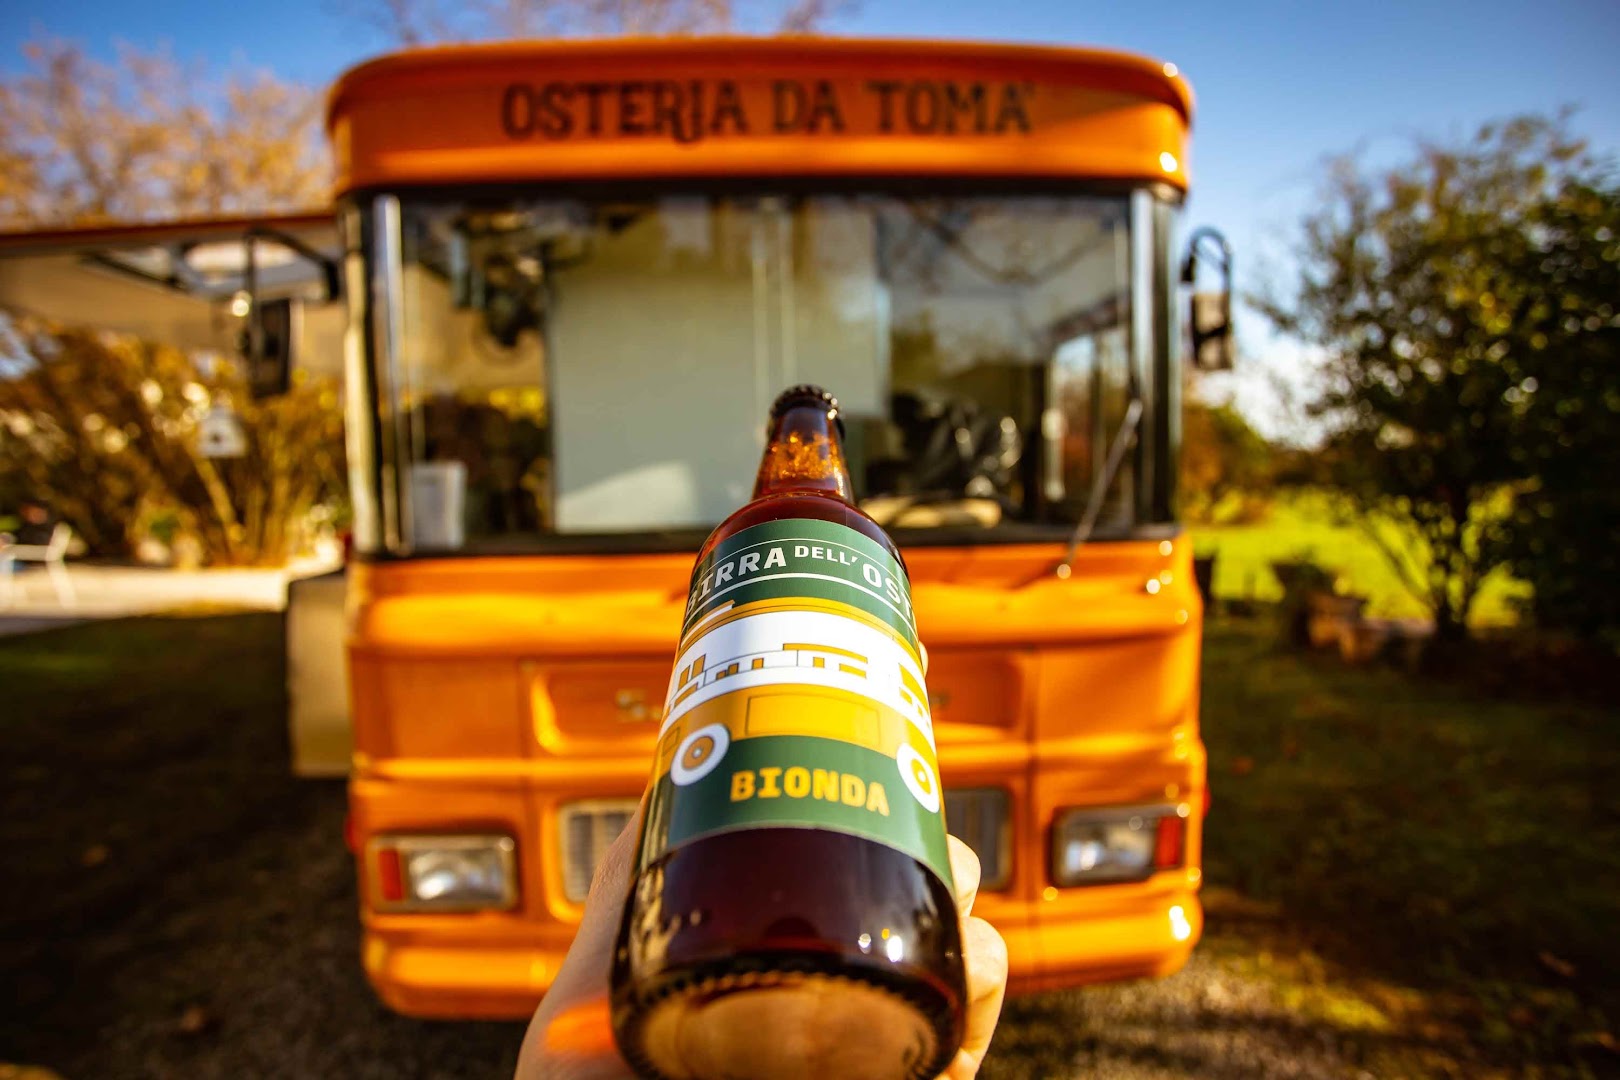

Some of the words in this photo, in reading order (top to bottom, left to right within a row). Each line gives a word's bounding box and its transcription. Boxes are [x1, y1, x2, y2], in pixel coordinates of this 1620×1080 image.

[502, 81, 745, 144] OSTERIA
[772, 80, 845, 135] DA
[686, 547, 786, 616] BIRRA
[730, 766, 890, 816] BIONDA
